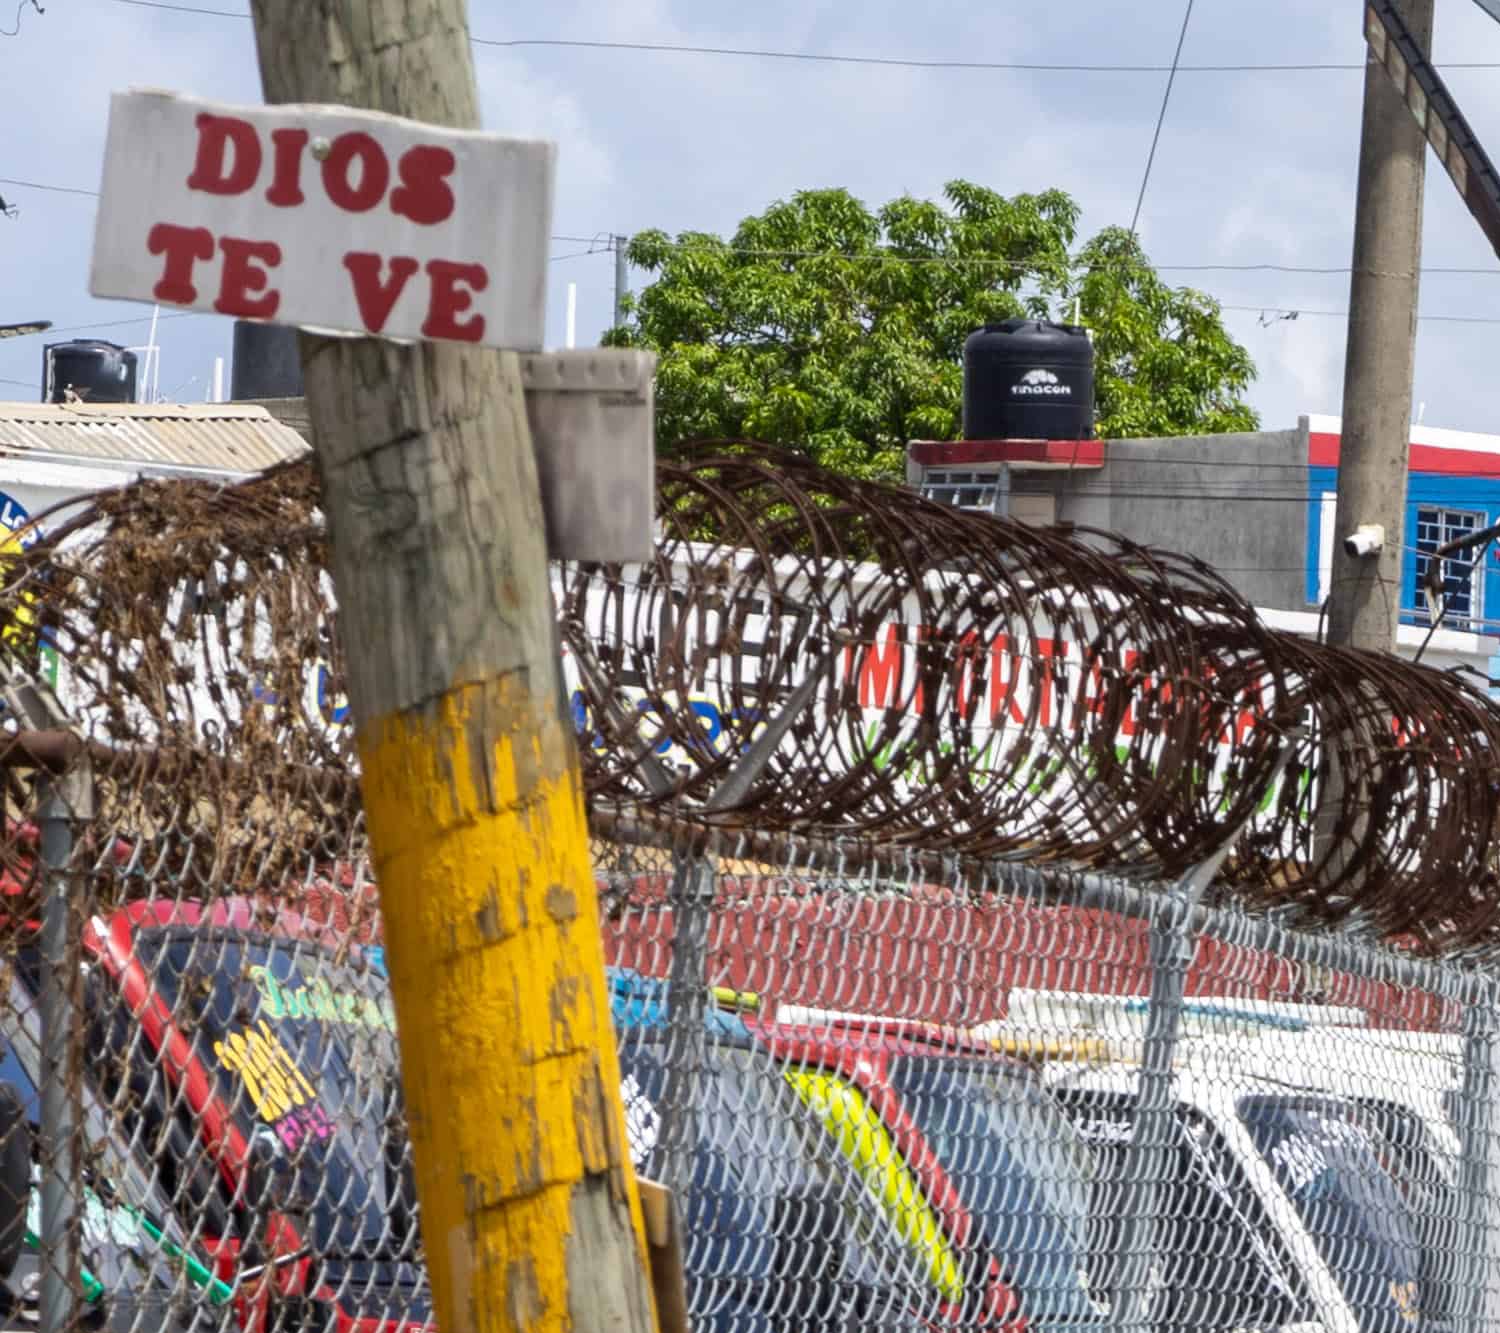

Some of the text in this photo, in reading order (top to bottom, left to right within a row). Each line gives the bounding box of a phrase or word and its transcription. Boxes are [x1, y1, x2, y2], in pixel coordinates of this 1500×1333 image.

[186, 112, 457, 226] DIOS
[146, 222, 490, 345] TE VE
